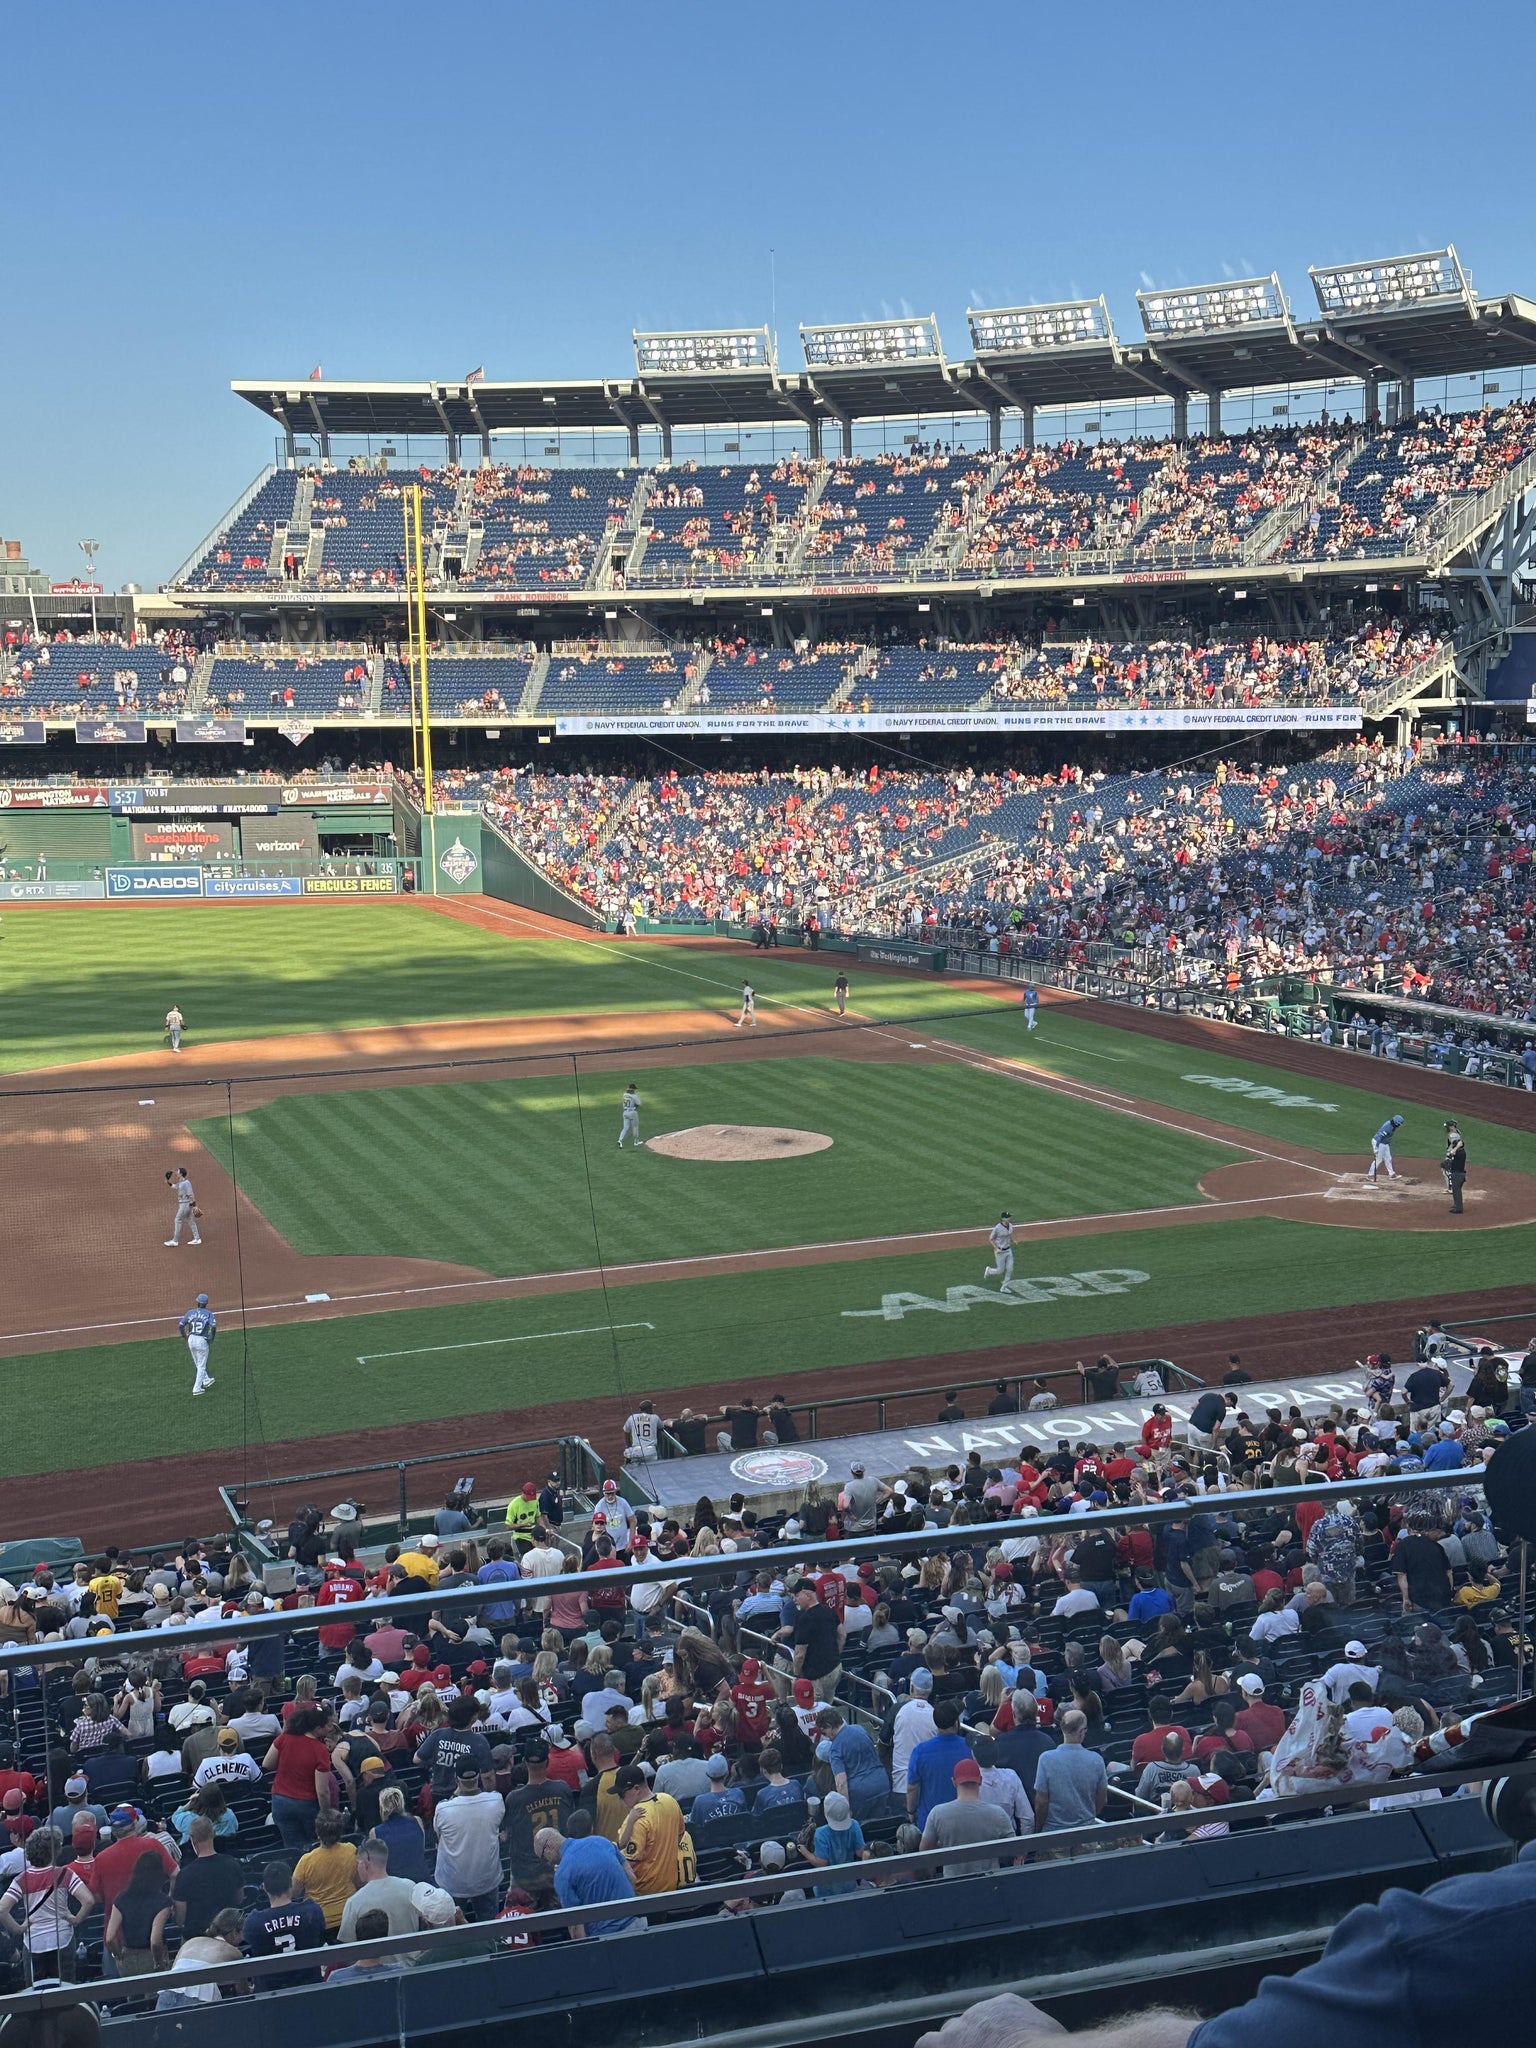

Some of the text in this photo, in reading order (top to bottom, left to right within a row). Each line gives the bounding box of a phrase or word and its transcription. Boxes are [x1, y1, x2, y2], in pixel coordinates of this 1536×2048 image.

[1123, 573, 1155, 583] JAYSON
[812, 585, 879, 595] FRANK HOWARD
[494, 593, 522, 602] FRANK
[707, 720, 734, 728] RUNS
[736, 720, 755, 728] FOR
[757, 720, 776, 728] THE
[893, 718, 914, 726] NAVY
[915, 718, 945, 726] FEDERAL
[946, 718, 972, 726] CREDIT
[1004, 717, 1032, 725] RUNS
[1033, 717, 1053, 725] FOR
[1075, 716, 1106, 724] BRAVE
[1191, 715, 1212, 723] NAVY
[1213, 715, 1245, 723] FEDERAL
[1246, 715, 1272, 723] CREDIT
[1305, 714, 1333, 722] RUNS
[594, 721, 615, 729] NAVY
[617, 721, 648, 729] FEDERAL
[15, 789, 72, 801] WASHINGTON
[115, 790, 137, 804] 5:37
[145, 788, 168, 797] YOU BY
[301, 788, 355, 800] WASHINGTON
[42, 795, 91, 807] NATIONALS
[122, 805, 159, 814] NATIONALS
[160, 805, 217, 814] PHILANTHROPIES
[157, 823, 205, 833] network
[144, 832, 219, 843] baseball fans
[164, 843, 203, 855] rely on
[256, 840, 300, 851] verizon
[381, 862, 393, 874] 335
[133, 877, 199, 889] DABOS
[214, 881, 279, 893] citycruises
[306, 879, 393, 892] HERCULES FENCE
[26, 886, 45, 895] RTX
[841, 1268, 1151, 1320] AARP
[191, 1321, 203, 1333] 12
[637, 1423, 651, 1437] 16
[329, 1584, 354, 1592] ABRAMS
[102, 1590, 112, 1602] 13
[745, 1701, 758, 1717] 3
[438, 1739, 471, 1754] SENIORS
[204, 1762, 249, 1779] CLEMENTE
[526, 1796, 562, 1813] CLEMENTE
[531, 1808, 559, 1834] 21
[264, 1915, 301, 1933] CREWS
